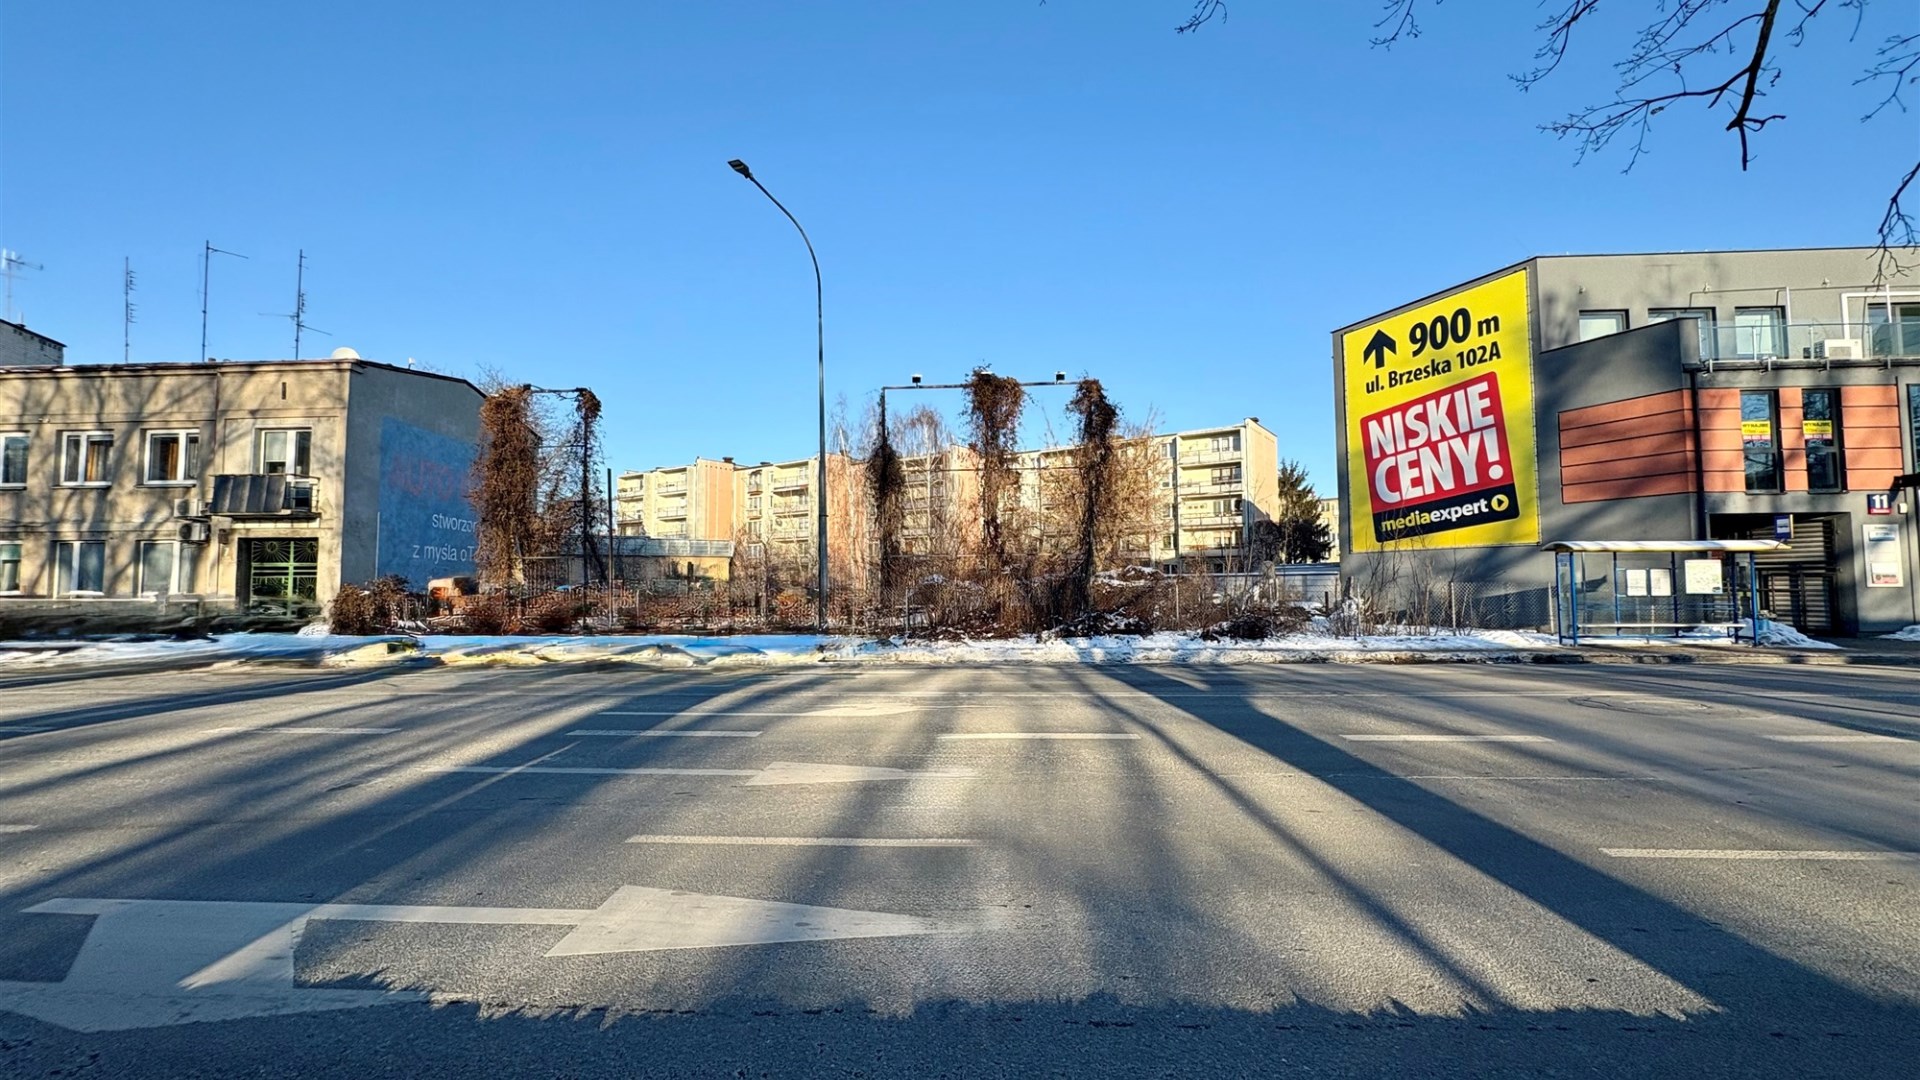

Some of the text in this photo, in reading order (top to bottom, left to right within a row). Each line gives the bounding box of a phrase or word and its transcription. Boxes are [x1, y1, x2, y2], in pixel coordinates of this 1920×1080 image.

[1409, 307, 1500, 357] 900 m
[1365, 341, 1501, 394] ul. Brzeska 102A
[1367, 381, 1495, 459] NISKIE
[1374, 427, 1505, 504] CENY!
[1381, 497, 1489, 532] mediaexpert
[1872, 494, 1889, 509] 11
[412, 545, 420, 558] z
